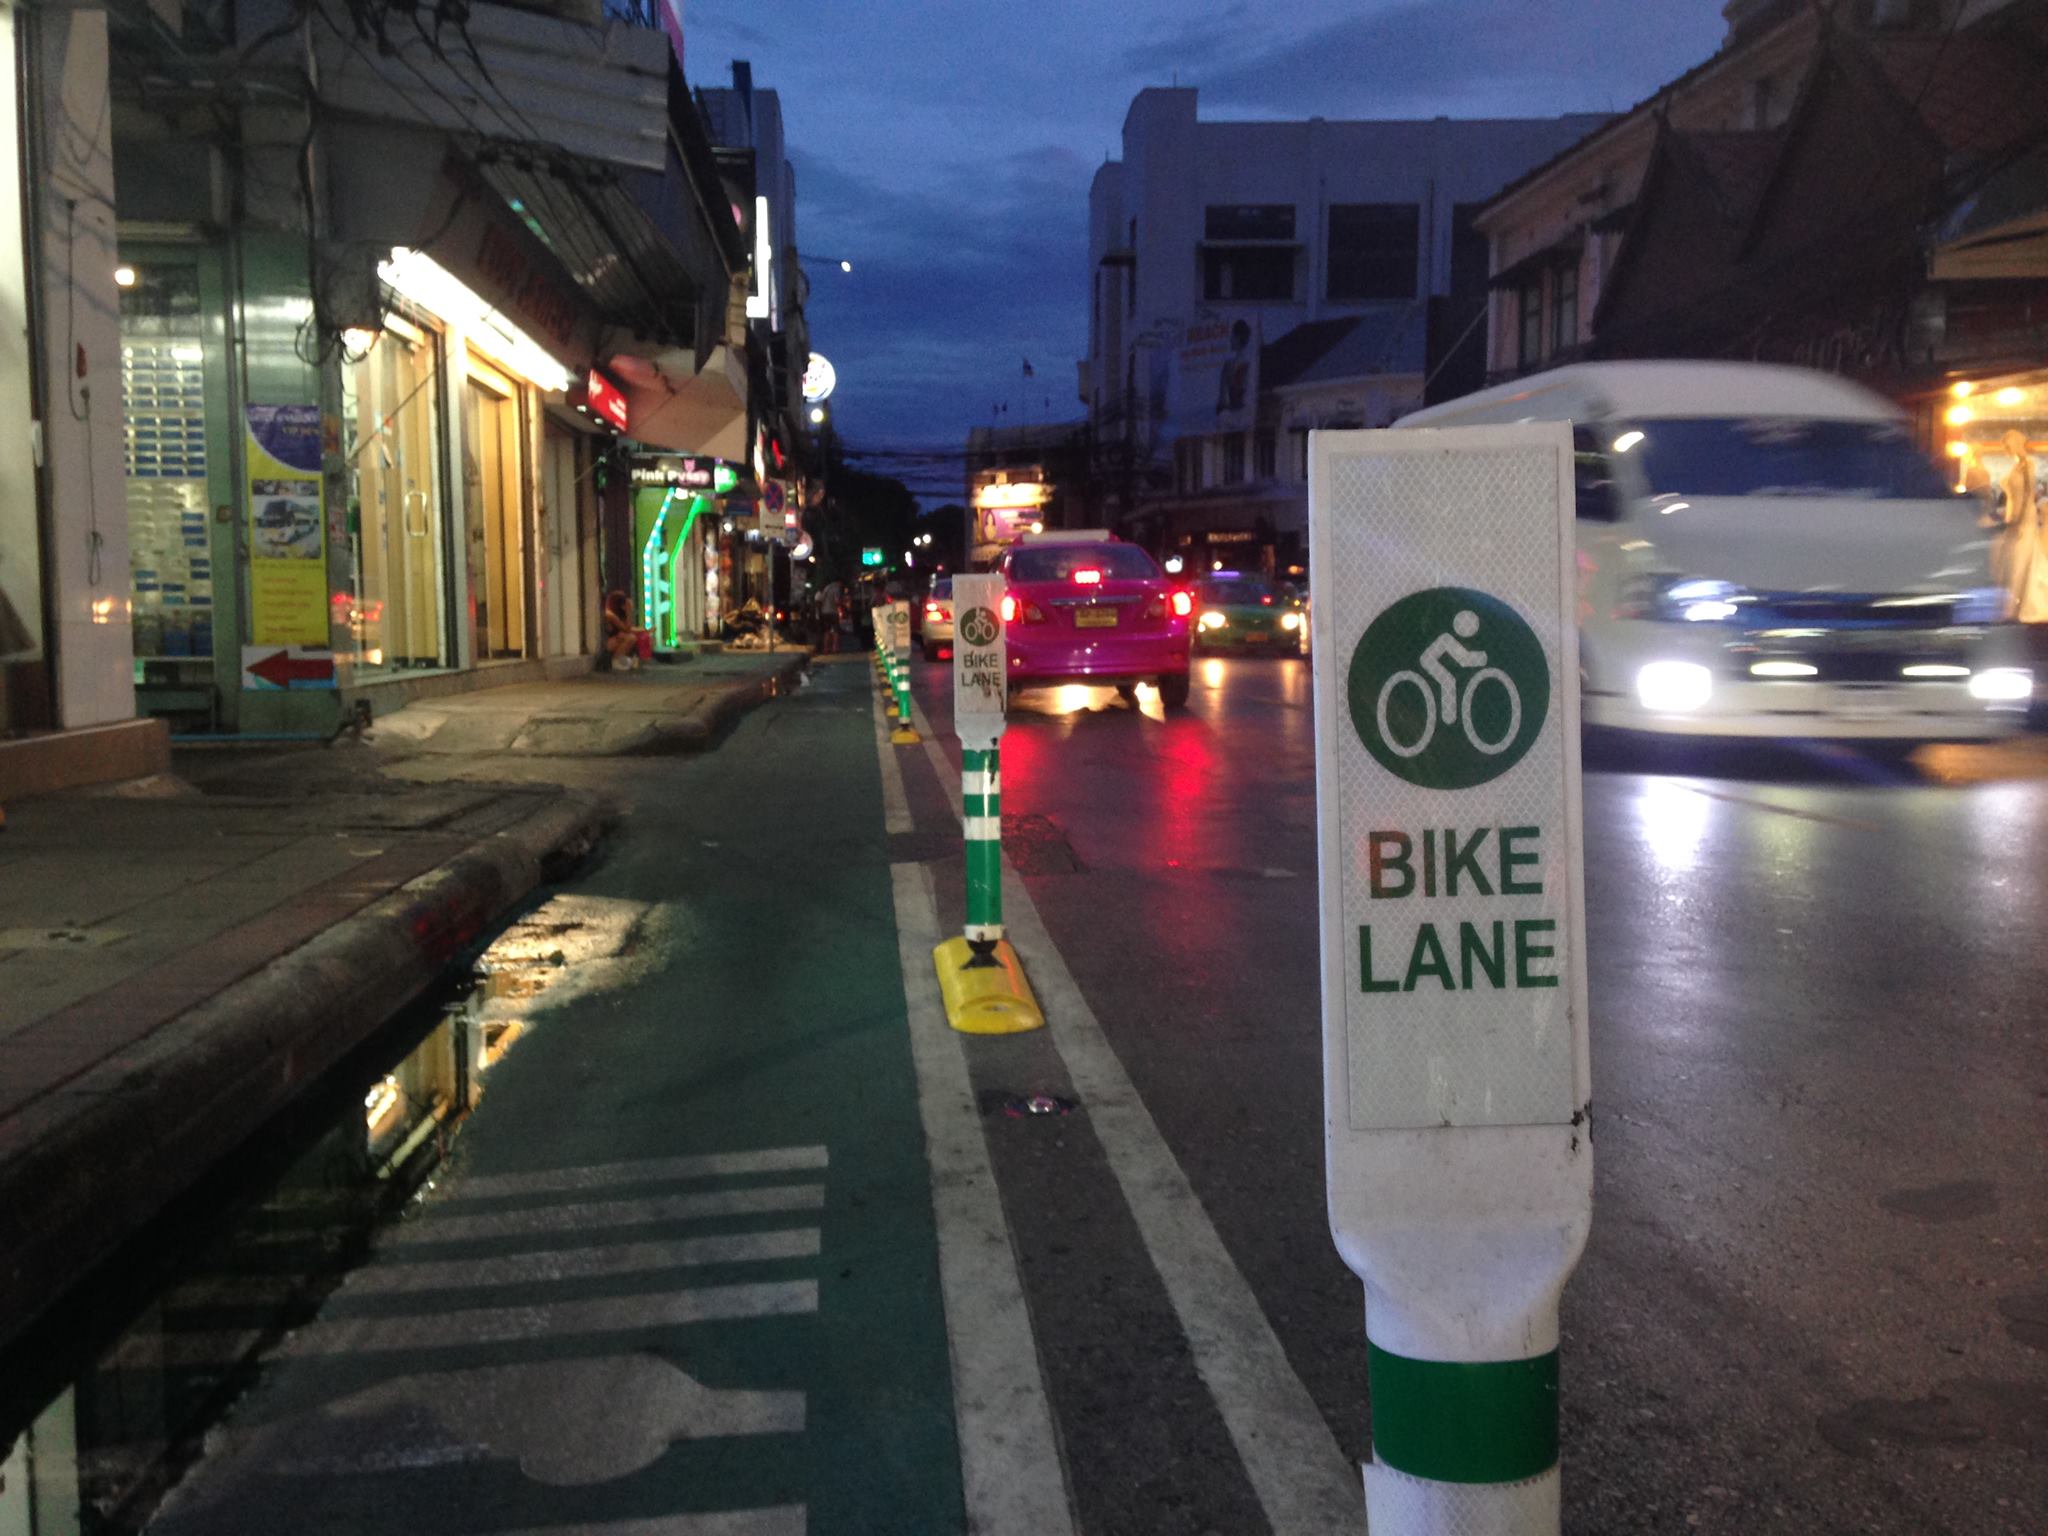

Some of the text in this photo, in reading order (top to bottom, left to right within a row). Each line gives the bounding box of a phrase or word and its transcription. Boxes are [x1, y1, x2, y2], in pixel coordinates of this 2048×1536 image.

[961, 672, 1001, 687] LANE
[963, 653, 998, 668] BIKE
[1369, 826, 1543, 899] BIKE
[1359, 919, 1559, 993] LANE
